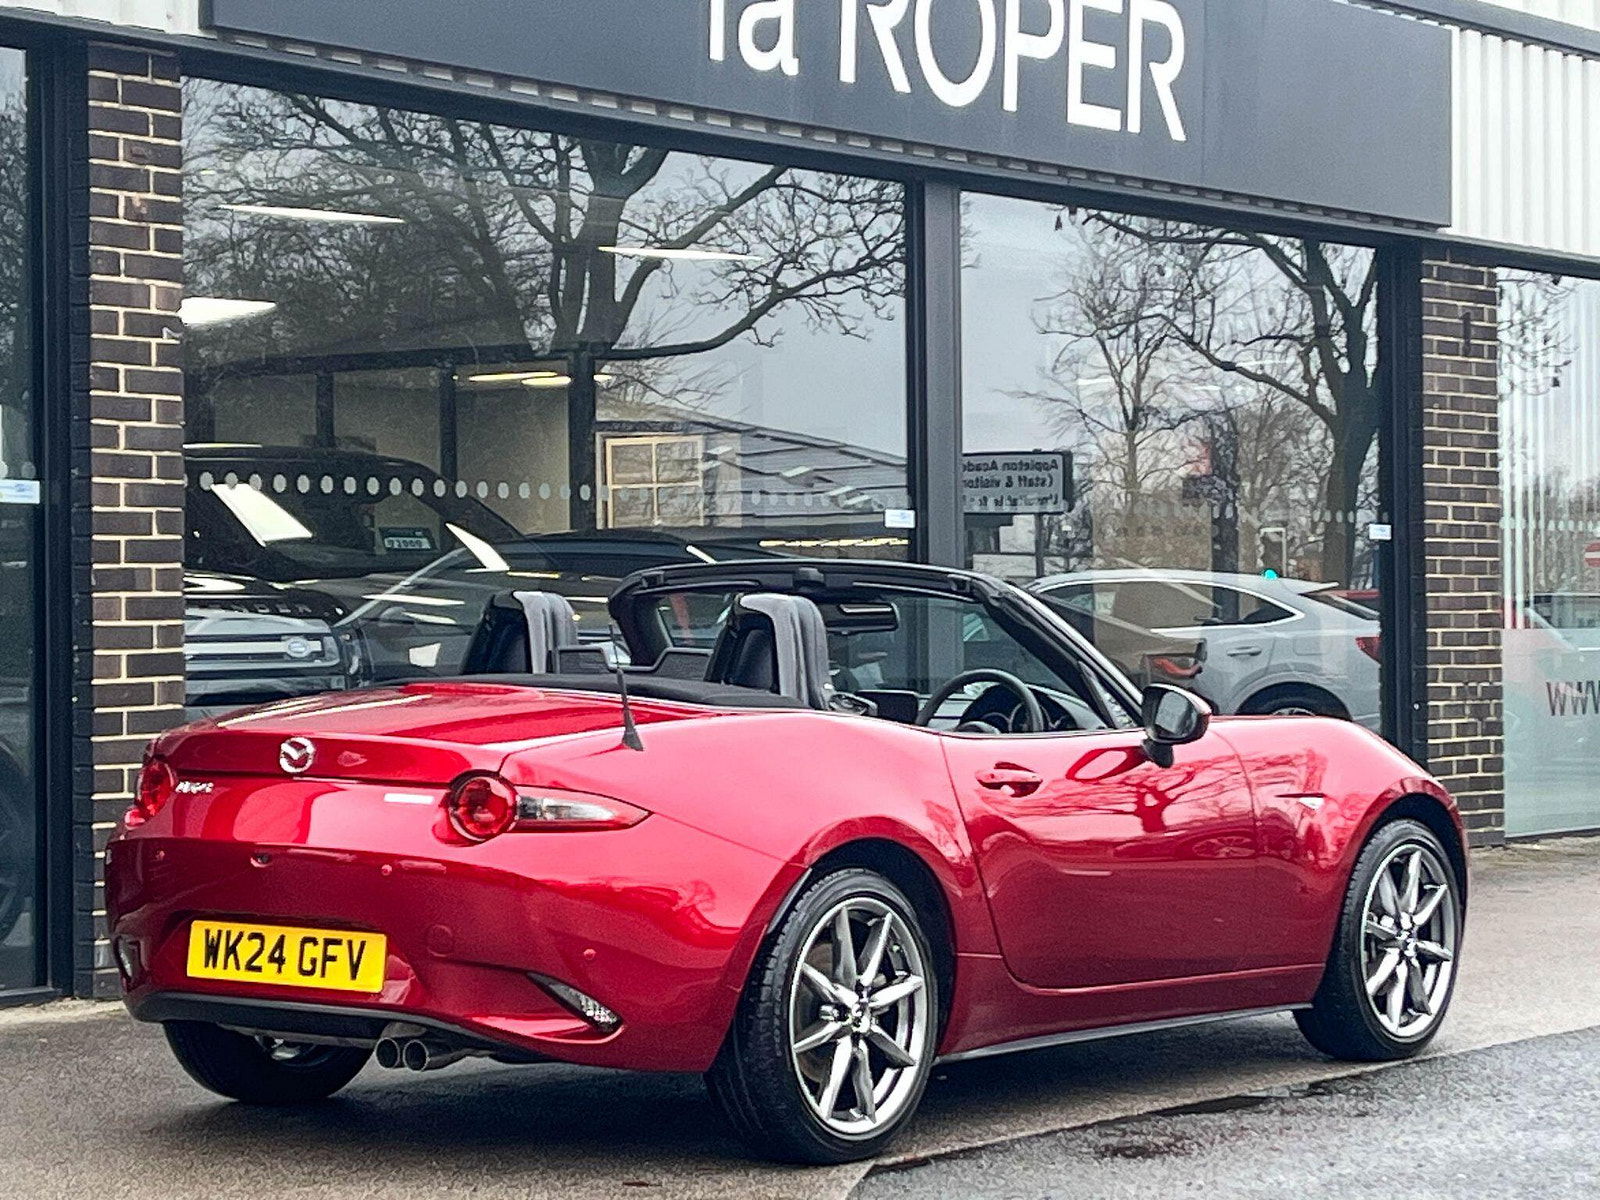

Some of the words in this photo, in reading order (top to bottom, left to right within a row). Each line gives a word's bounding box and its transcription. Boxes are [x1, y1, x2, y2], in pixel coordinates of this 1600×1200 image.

[839, 0, 1187, 141] ROPER
[204, 928, 286, 975] WK24
[298, 935, 367, 981] GFV
